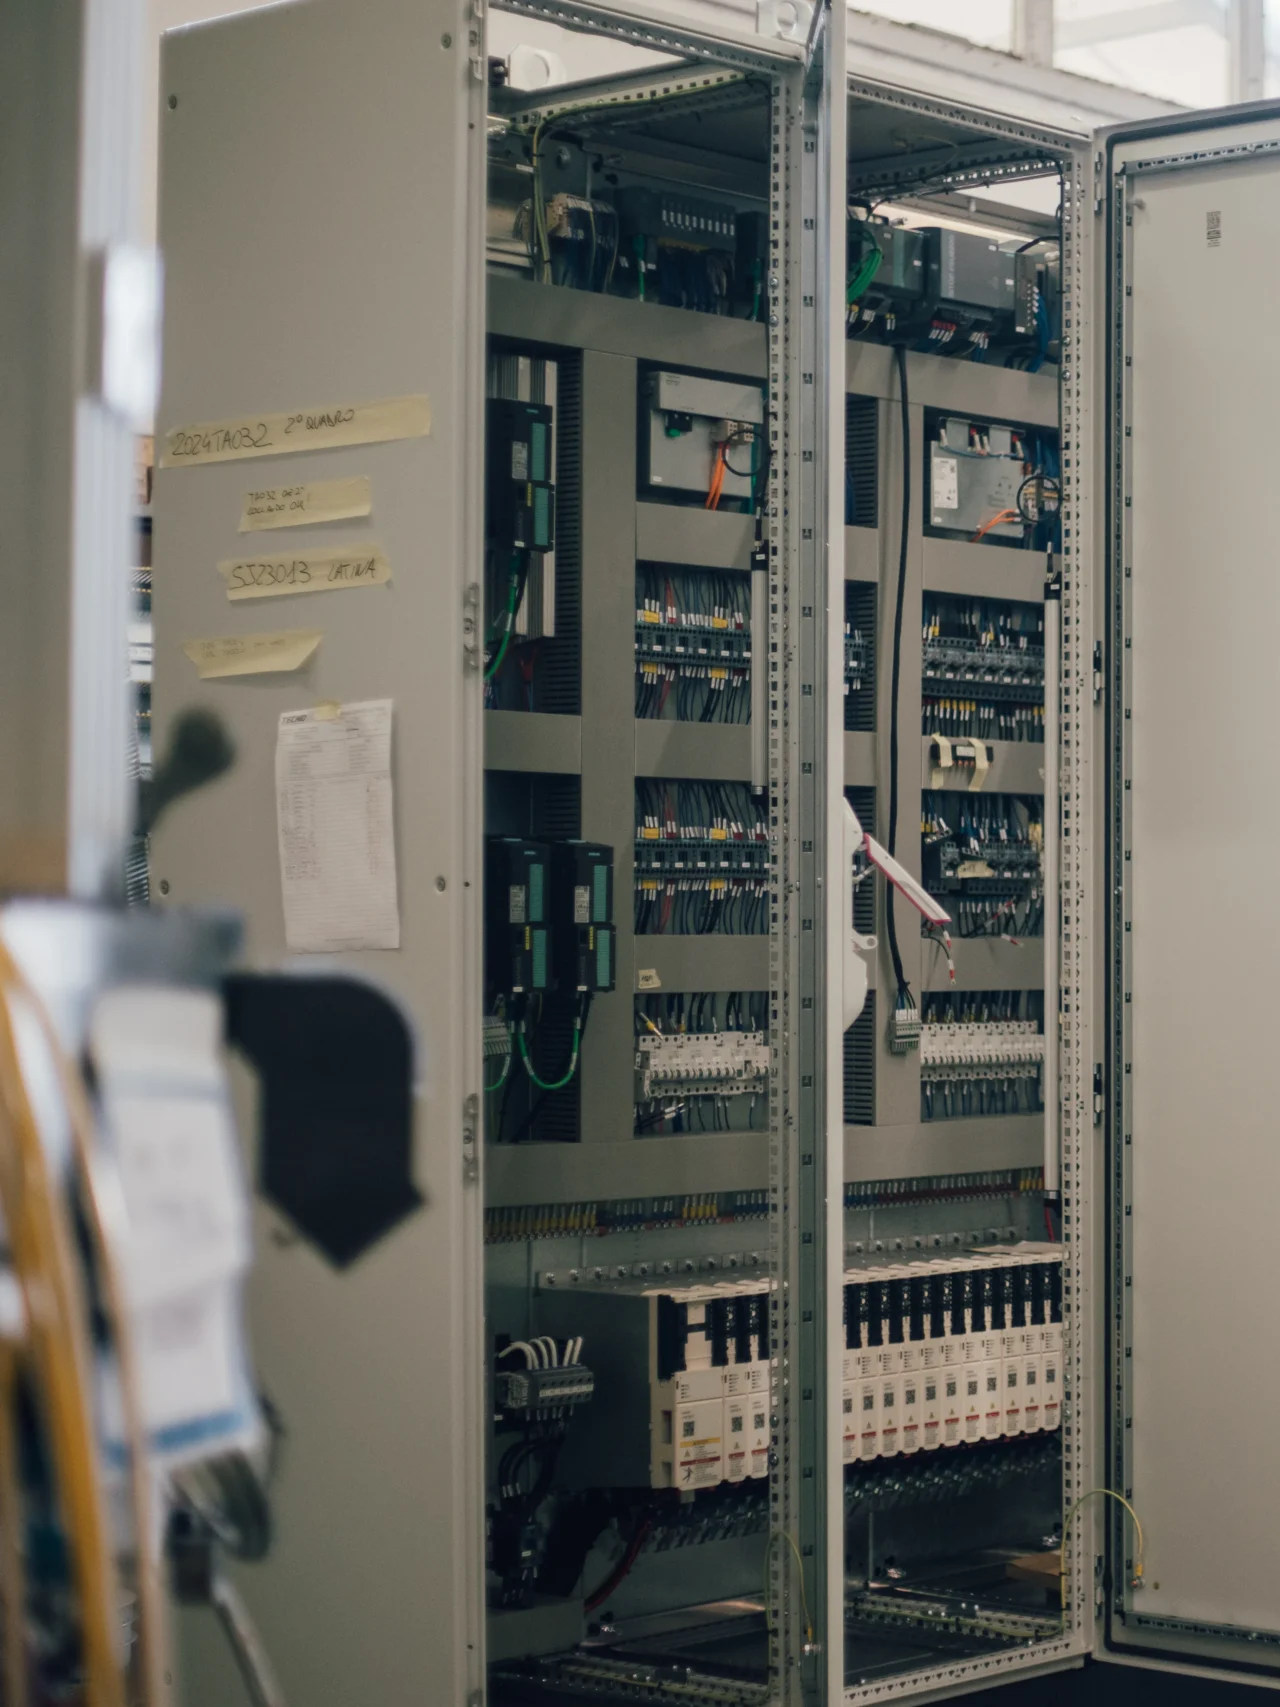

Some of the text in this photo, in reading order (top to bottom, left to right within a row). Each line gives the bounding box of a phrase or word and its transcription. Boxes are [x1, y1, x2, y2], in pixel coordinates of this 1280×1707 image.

[171, 423, 273, 456] 2024TA032
[305, 409, 355, 430] QUADRO
[327, 557, 376, 582] LATINA
